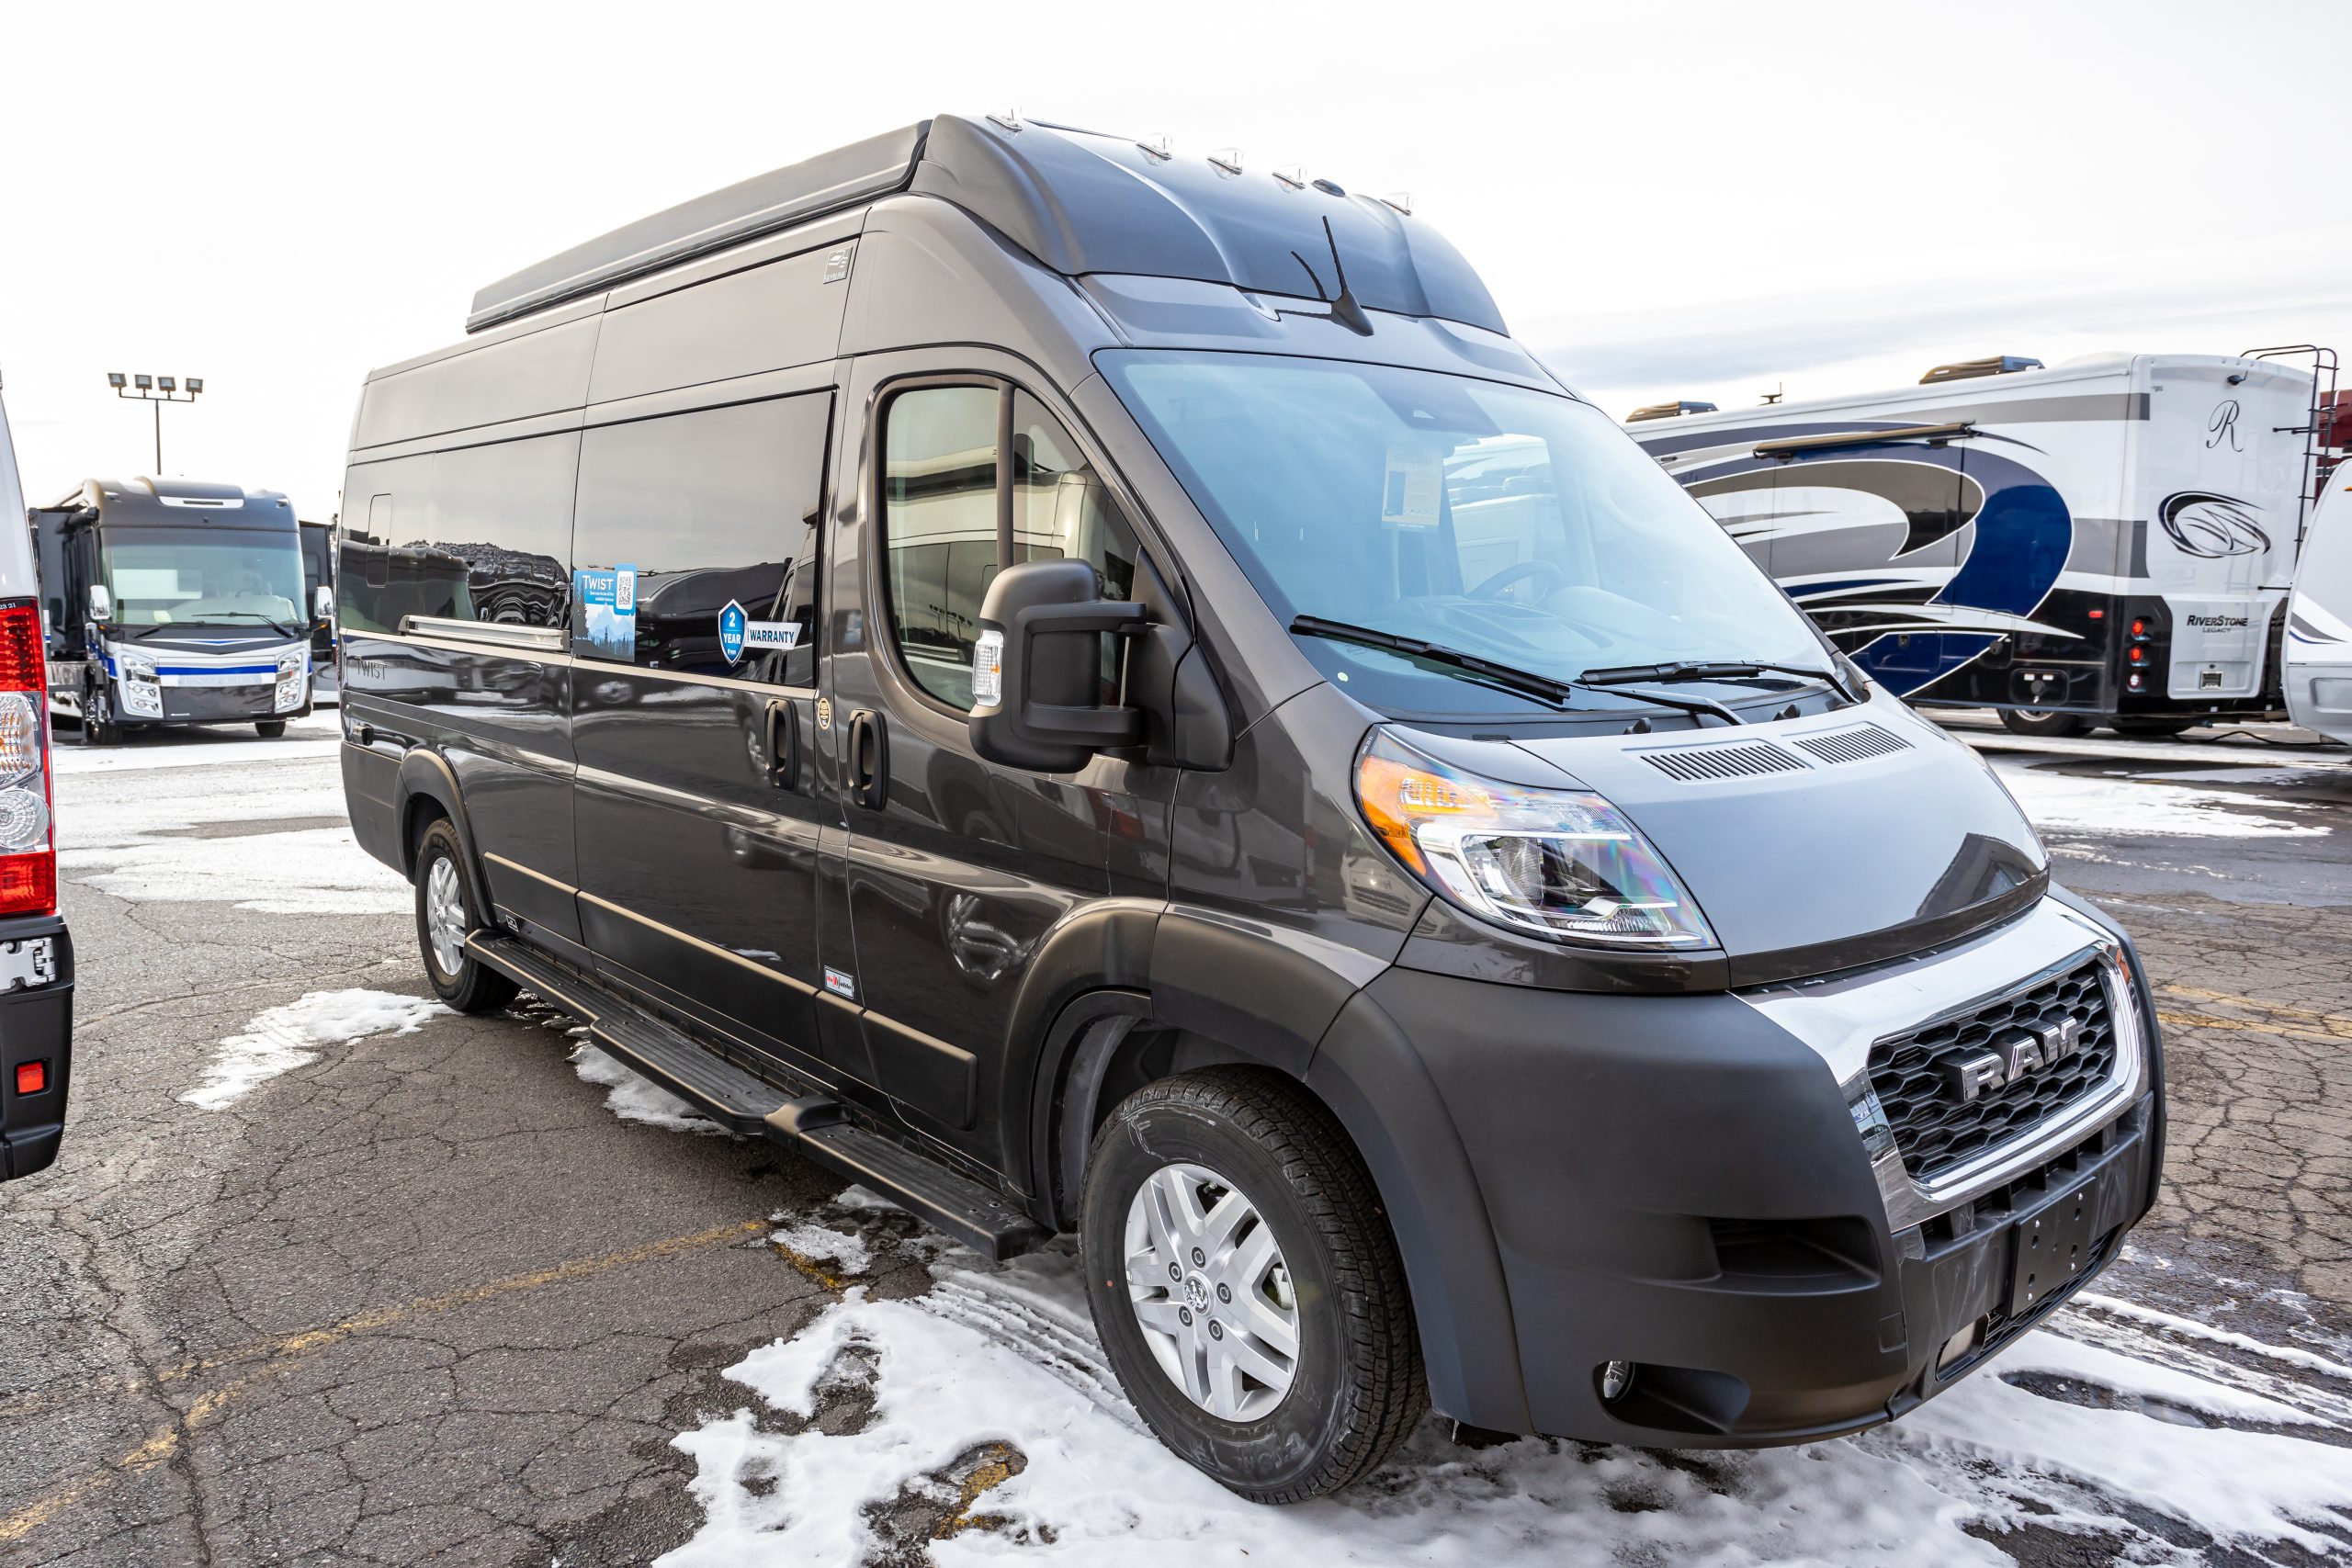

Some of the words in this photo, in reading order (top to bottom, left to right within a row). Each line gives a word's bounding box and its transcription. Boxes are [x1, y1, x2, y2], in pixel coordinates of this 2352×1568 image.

[582, 575, 614, 591] TWIST
[729, 611, 736, 627] 2
[723, 632, 741, 645] YEAR
[750, 629, 795, 644] WARRANTY
[354, 655, 387, 680] TWIST
[1960, 1014, 2080, 1101] RAM
